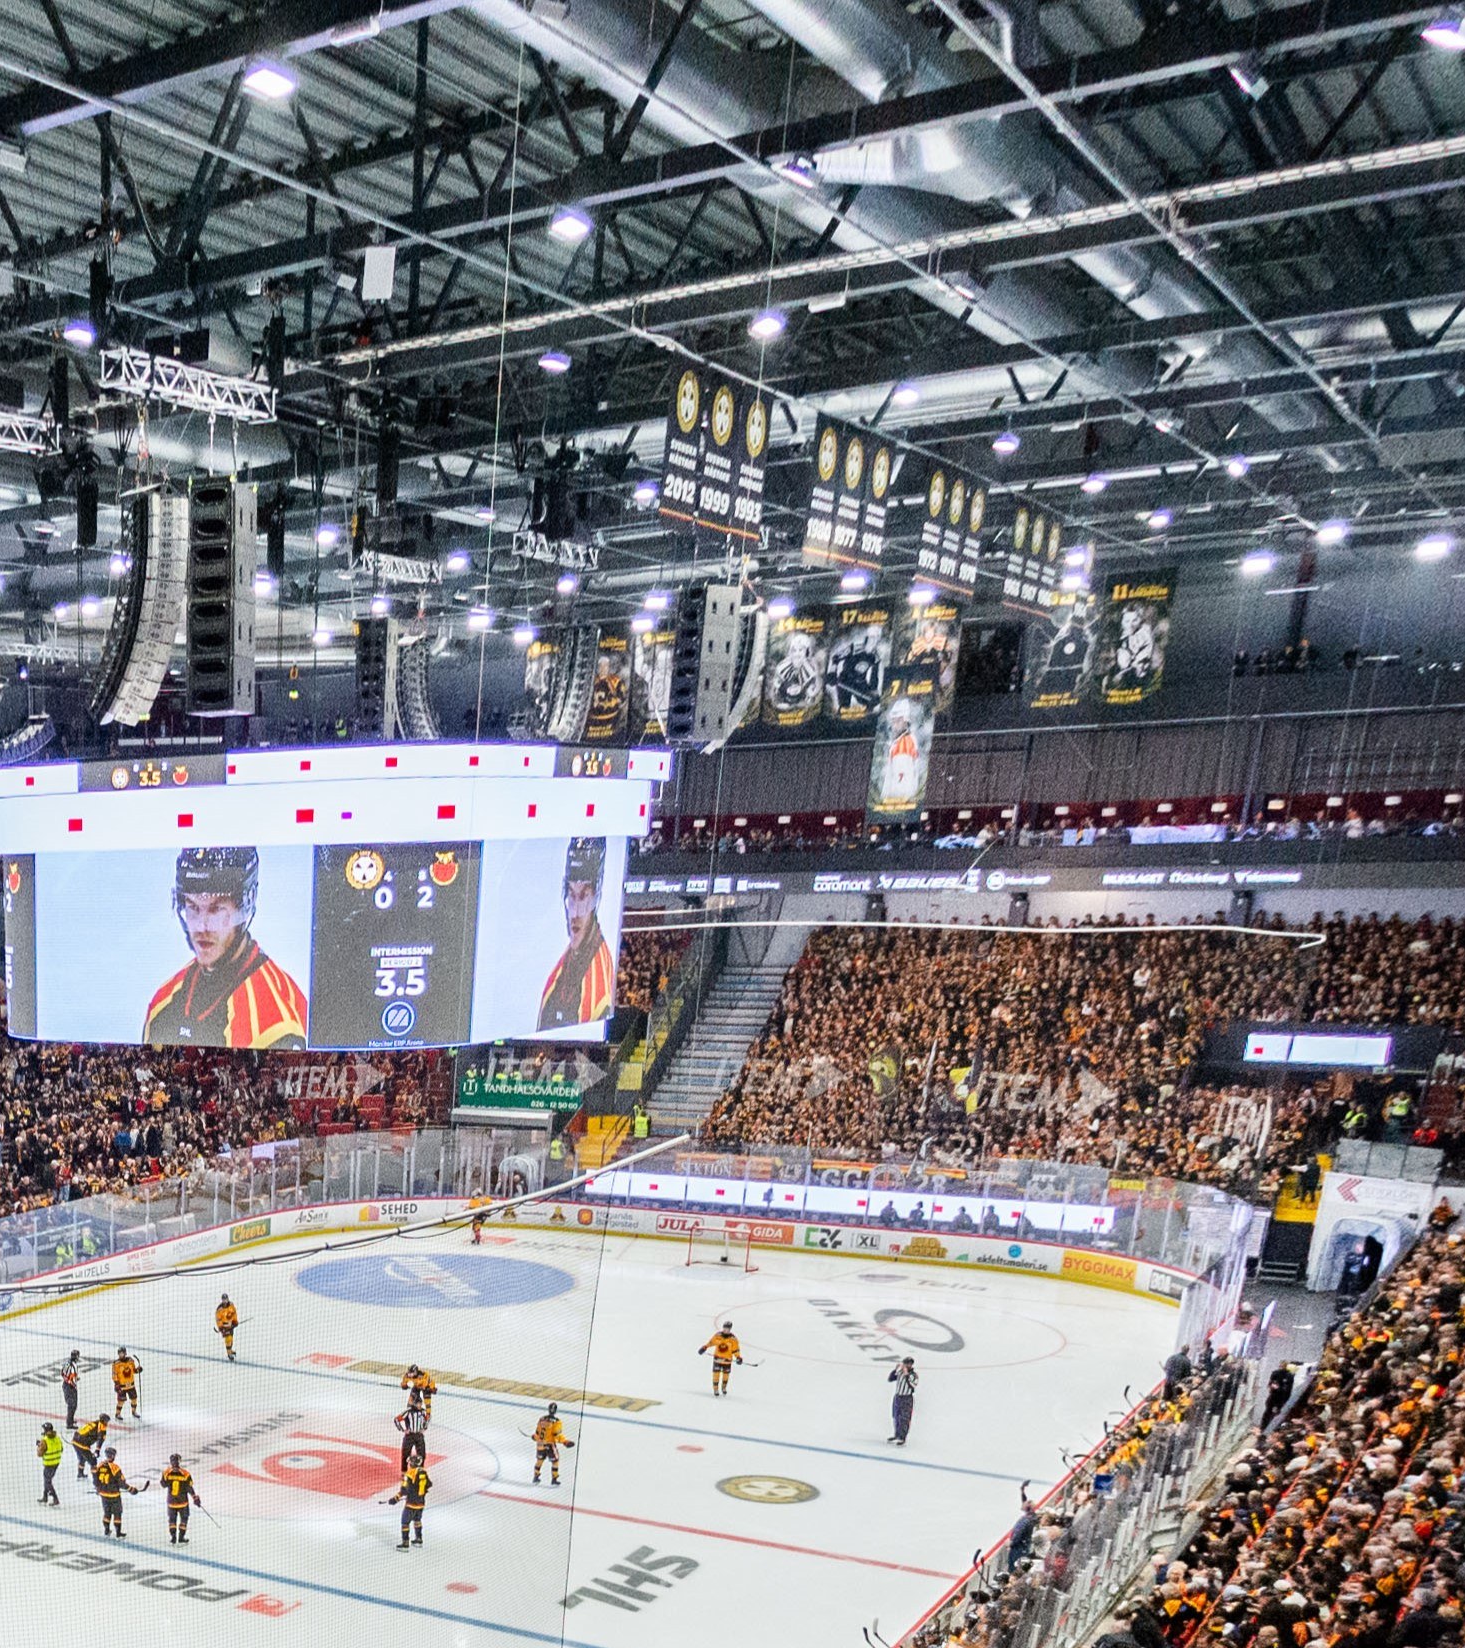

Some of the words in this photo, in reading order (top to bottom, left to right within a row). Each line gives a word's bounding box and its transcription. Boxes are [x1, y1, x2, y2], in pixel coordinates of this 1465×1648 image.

[664, 474, 696, 501] 2012
[700, 487, 730, 515] 1999
[734, 497, 762, 524] 1993
[834, 525, 857, 549] 1977
[374, 886, 393, 909] 0
[417, 886, 433, 908] 2
[371, 946, 432, 957] INTERMISSION
[383, 959, 412, 967] PERIOD
[374, 969, 425, 997] 3.5
[369, 1039, 392, 1047] Monitor
[381, 1203, 418, 1216] SEHED
[233, 1222, 267, 1243] Cheers
[658, 1217, 702, 1233] JULA
[752, 1226, 784, 1239] GIDA
[858, 1235, 879, 1248] XL
[1063, 1256, 1135, 1281] BYGGMAX
[917, 1279, 988, 1292] Telia
[559, 1545, 699, 1613] SHL
